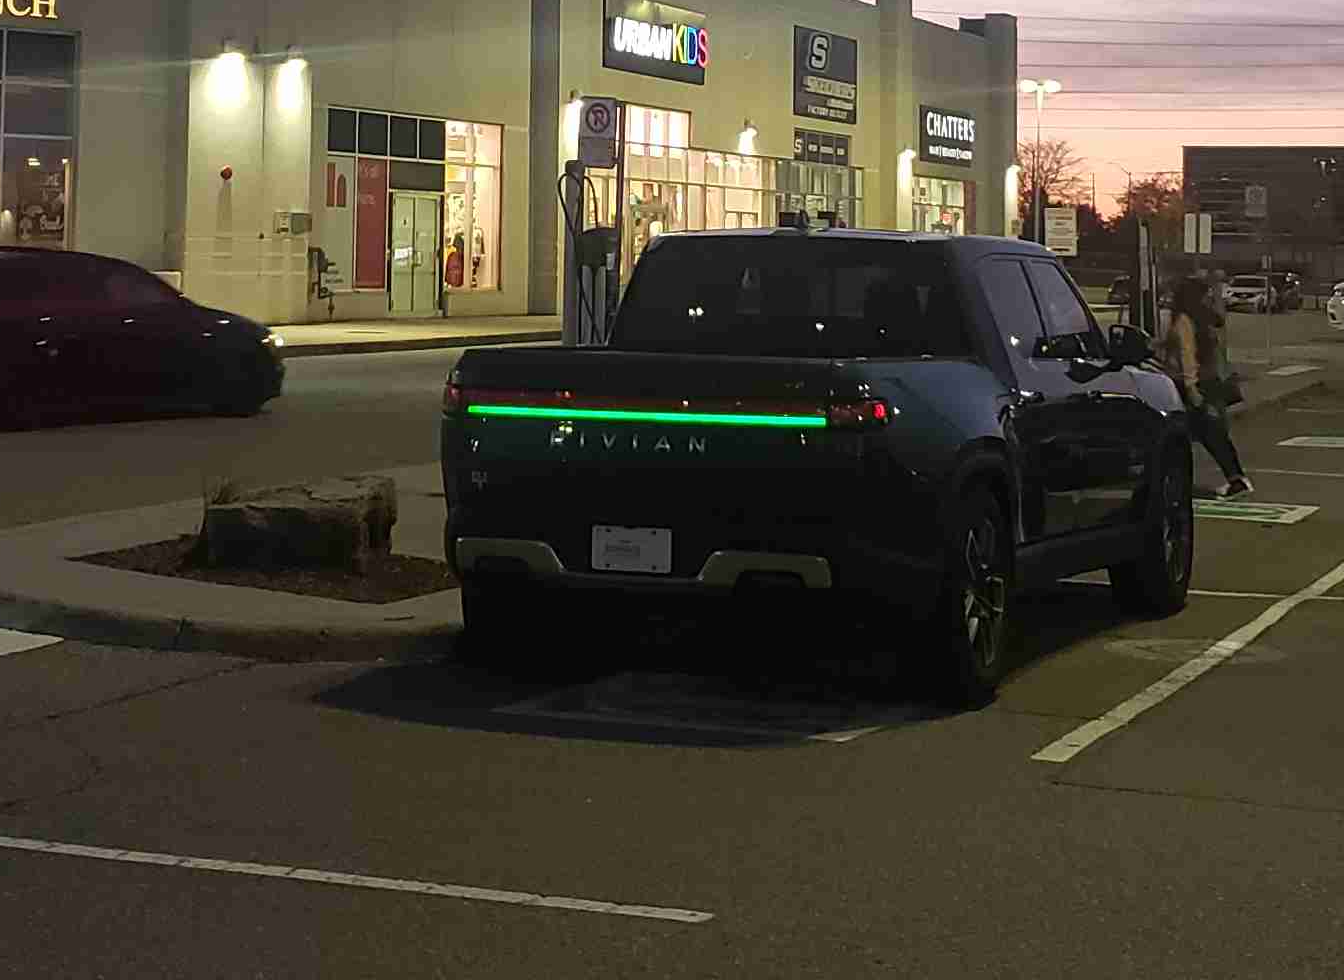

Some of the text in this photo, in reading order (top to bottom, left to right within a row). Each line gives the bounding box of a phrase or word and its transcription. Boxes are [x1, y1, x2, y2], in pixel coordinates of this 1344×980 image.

[811, 36, 828, 70] S
[926, 111, 976, 143] CHATTERS
[550, 430, 706, 454] RIVIAN
